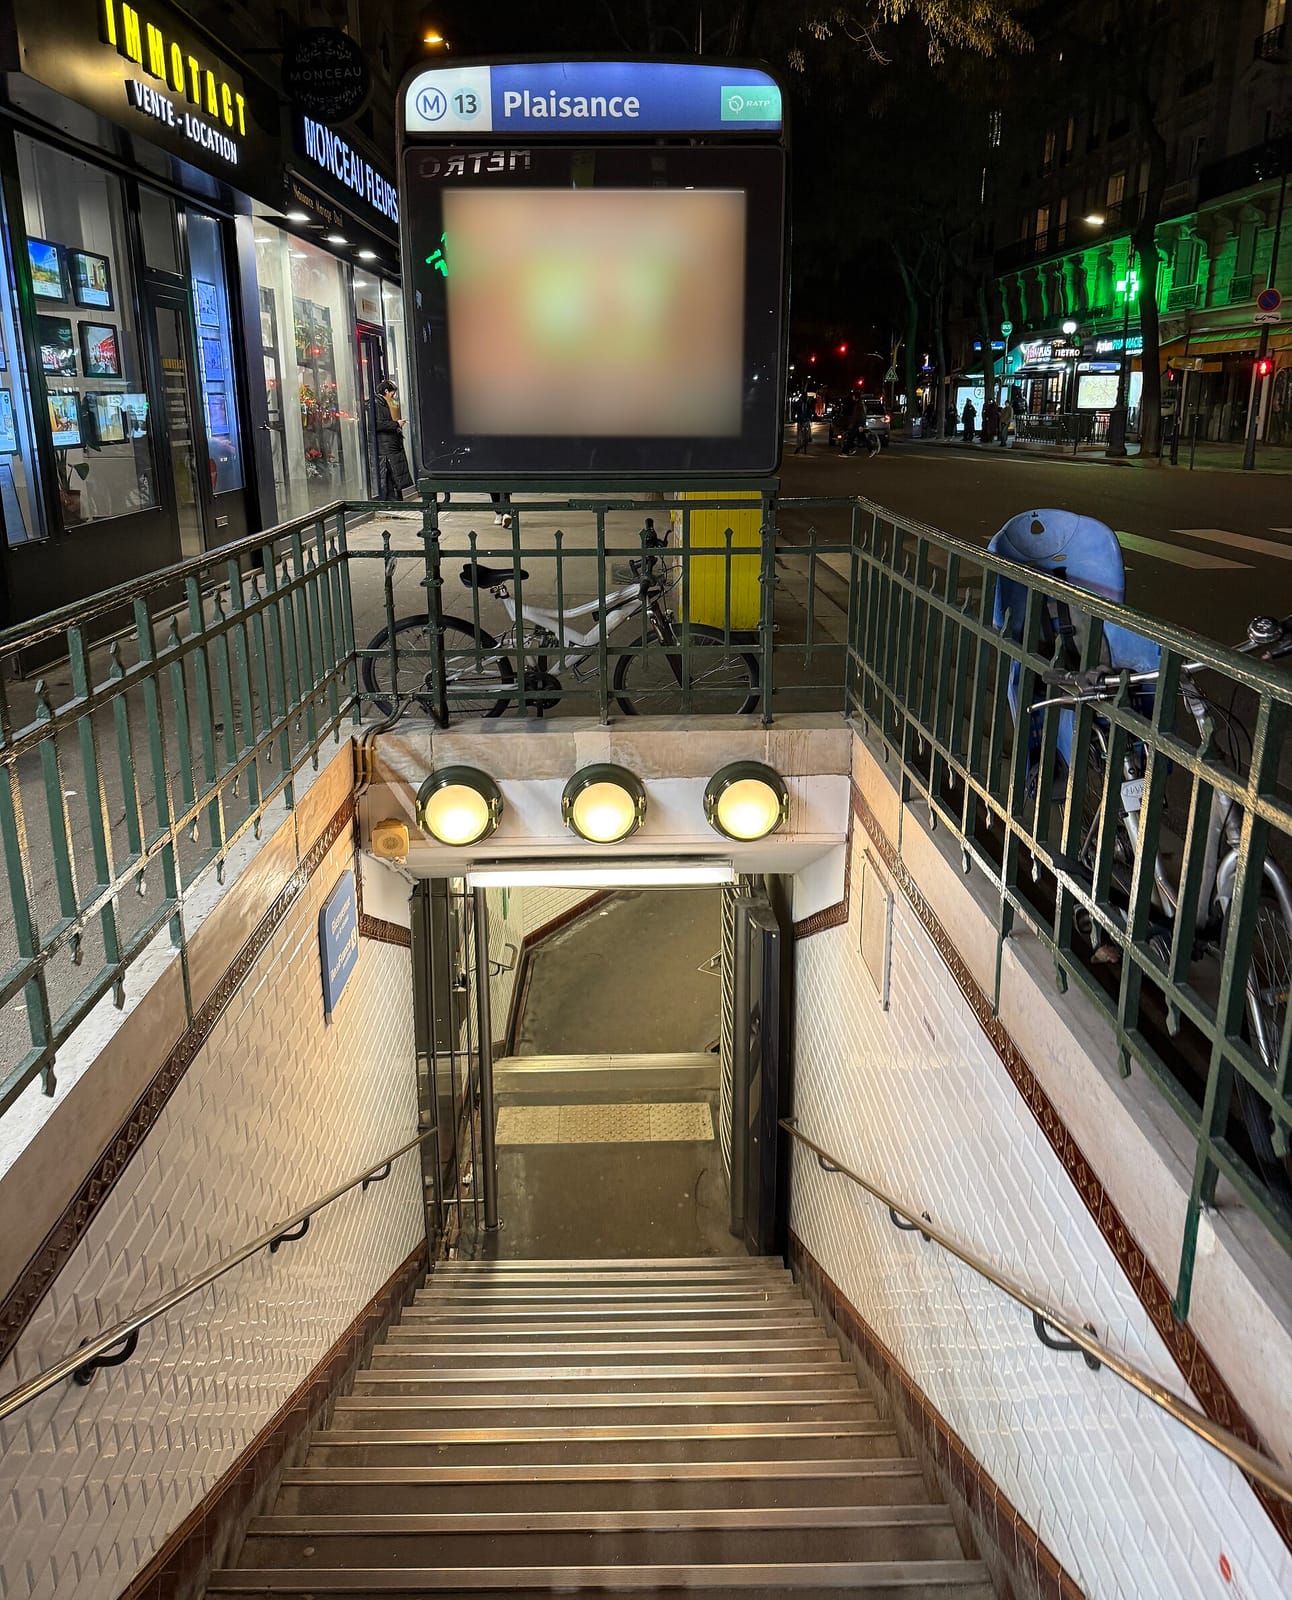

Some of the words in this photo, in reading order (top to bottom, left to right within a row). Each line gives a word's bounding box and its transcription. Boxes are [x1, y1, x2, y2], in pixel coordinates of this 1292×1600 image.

[106, 0, 245, 136] IMMOTACT
[290, 65, 363, 81] MONCEAU
[454, 94, 478, 114] 13
[503, 89, 641, 118] Plaisance
[133, 79, 175, 127] VENTE
[185, 112, 238, 165] LOCATION
[304, 116, 364, 197] MONCEAU
[365, 163, 399, 224] FLEURS
